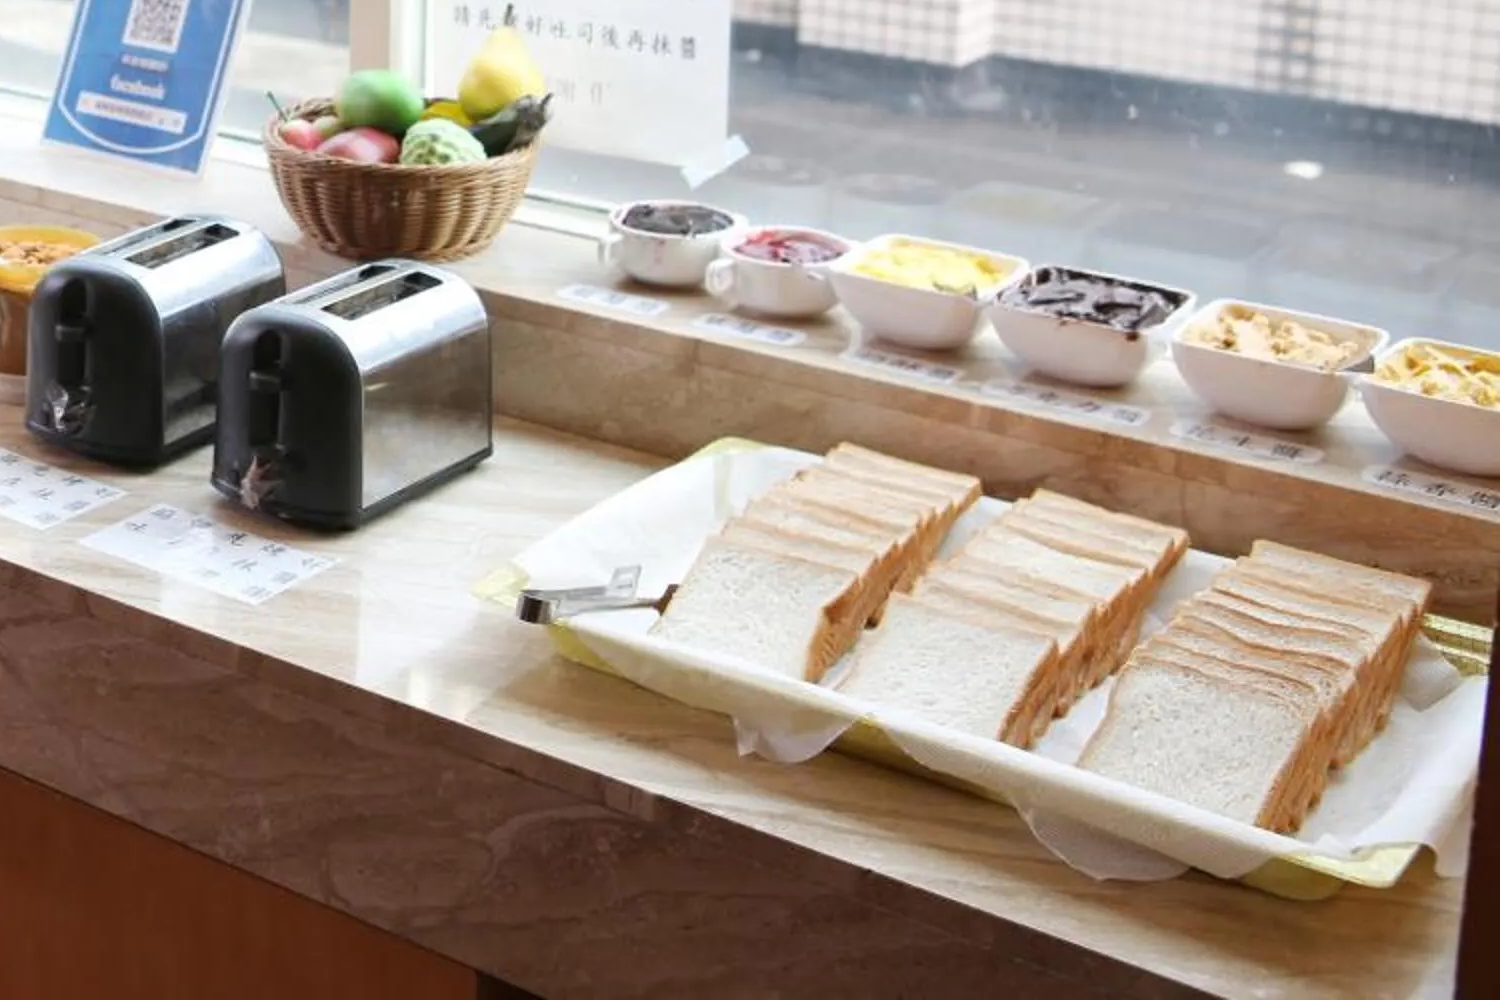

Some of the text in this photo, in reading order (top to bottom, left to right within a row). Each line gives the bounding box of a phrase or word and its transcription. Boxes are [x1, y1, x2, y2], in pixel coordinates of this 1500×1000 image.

[452, 3, 699, 61] 請先好吐司後再抹醬
